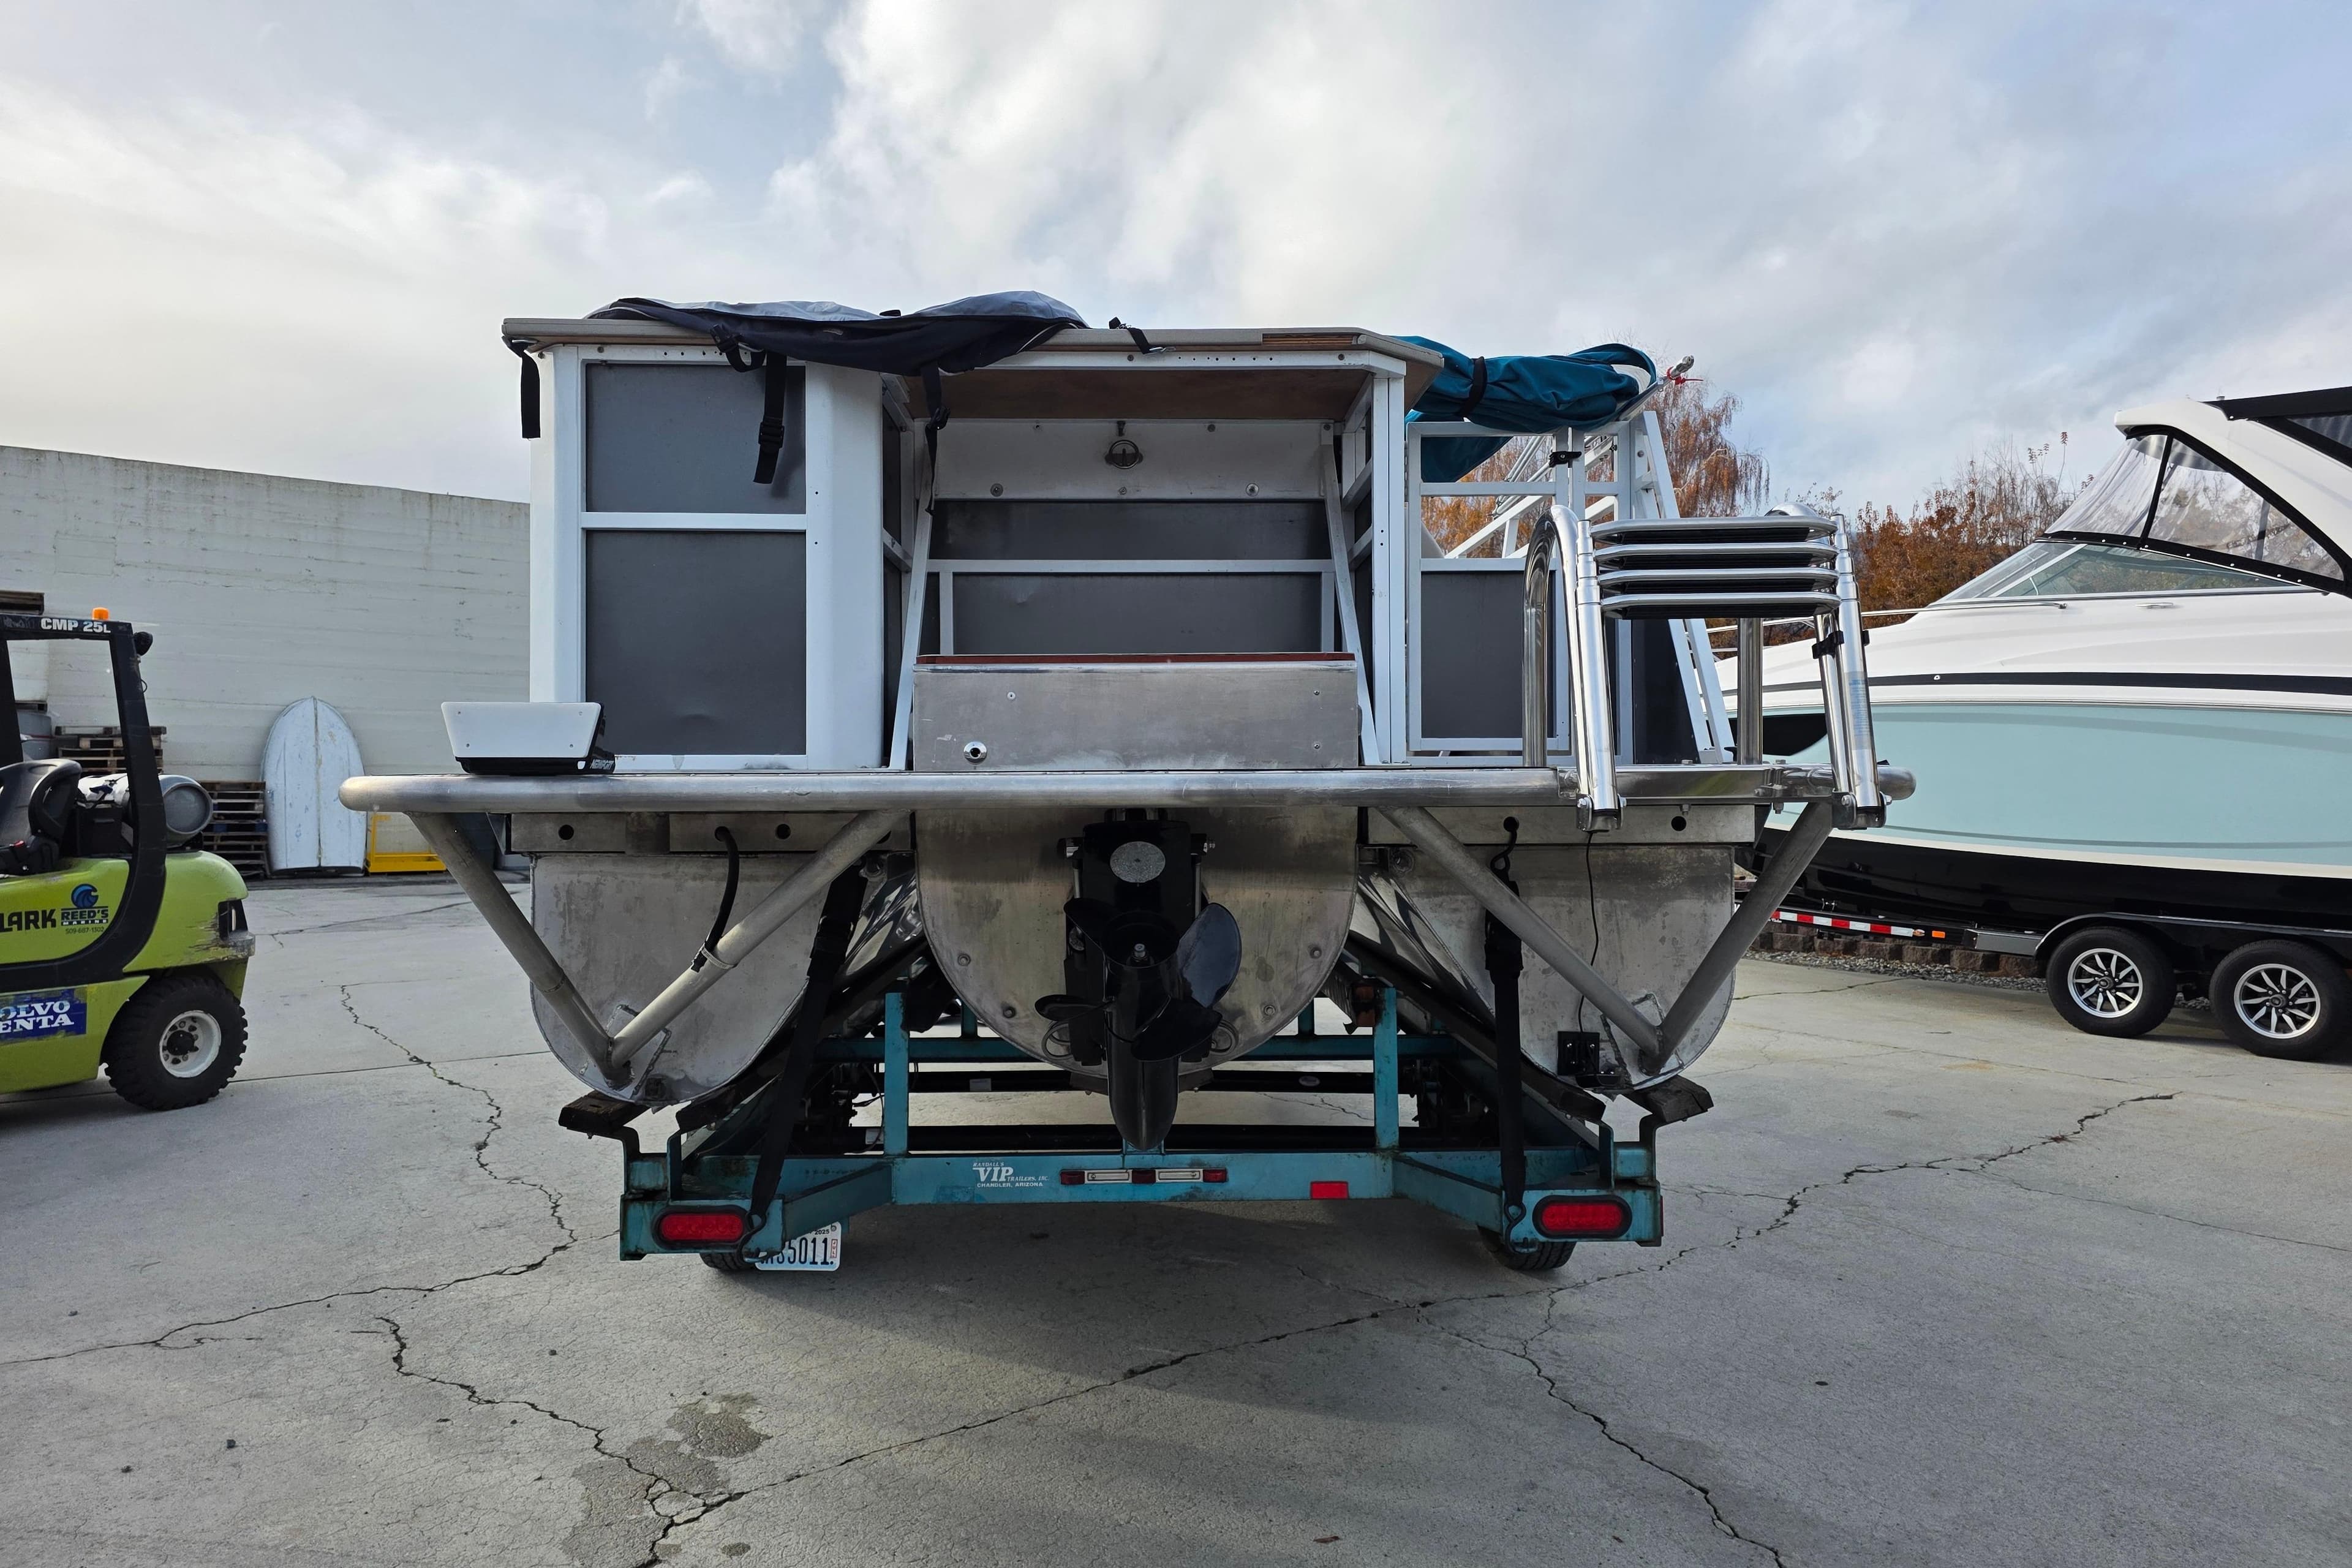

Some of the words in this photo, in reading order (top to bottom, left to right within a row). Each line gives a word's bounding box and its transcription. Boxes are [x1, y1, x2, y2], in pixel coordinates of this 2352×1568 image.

[40, 617, 78, 631] CMP
[61, 909, 108, 921] REED'S
[973, 1166, 1014, 1182] VIP
